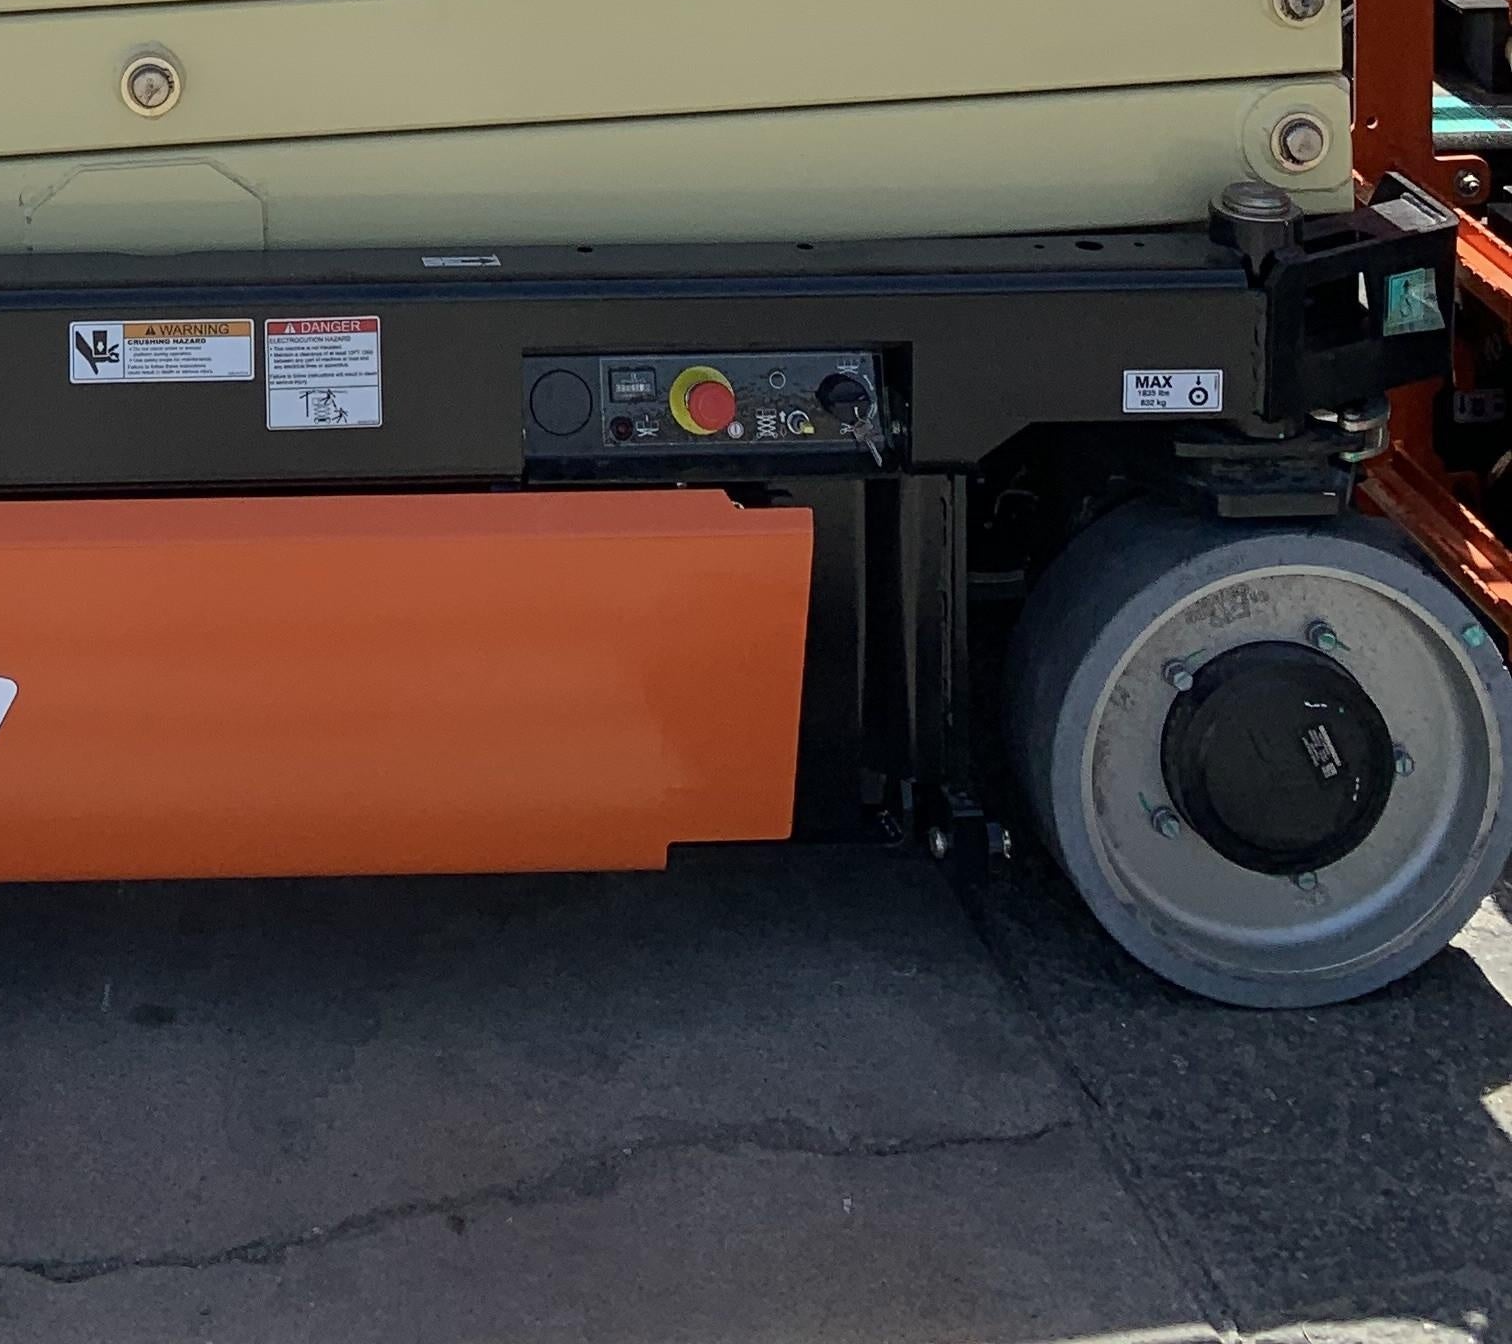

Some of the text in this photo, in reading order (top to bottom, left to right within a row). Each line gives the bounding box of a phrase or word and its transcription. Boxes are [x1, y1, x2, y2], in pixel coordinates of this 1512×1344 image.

[160, 323, 229, 335] WARNING
[301, 320, 361, 333] DANGER
[1135, 375, 1173, 389] MAX
